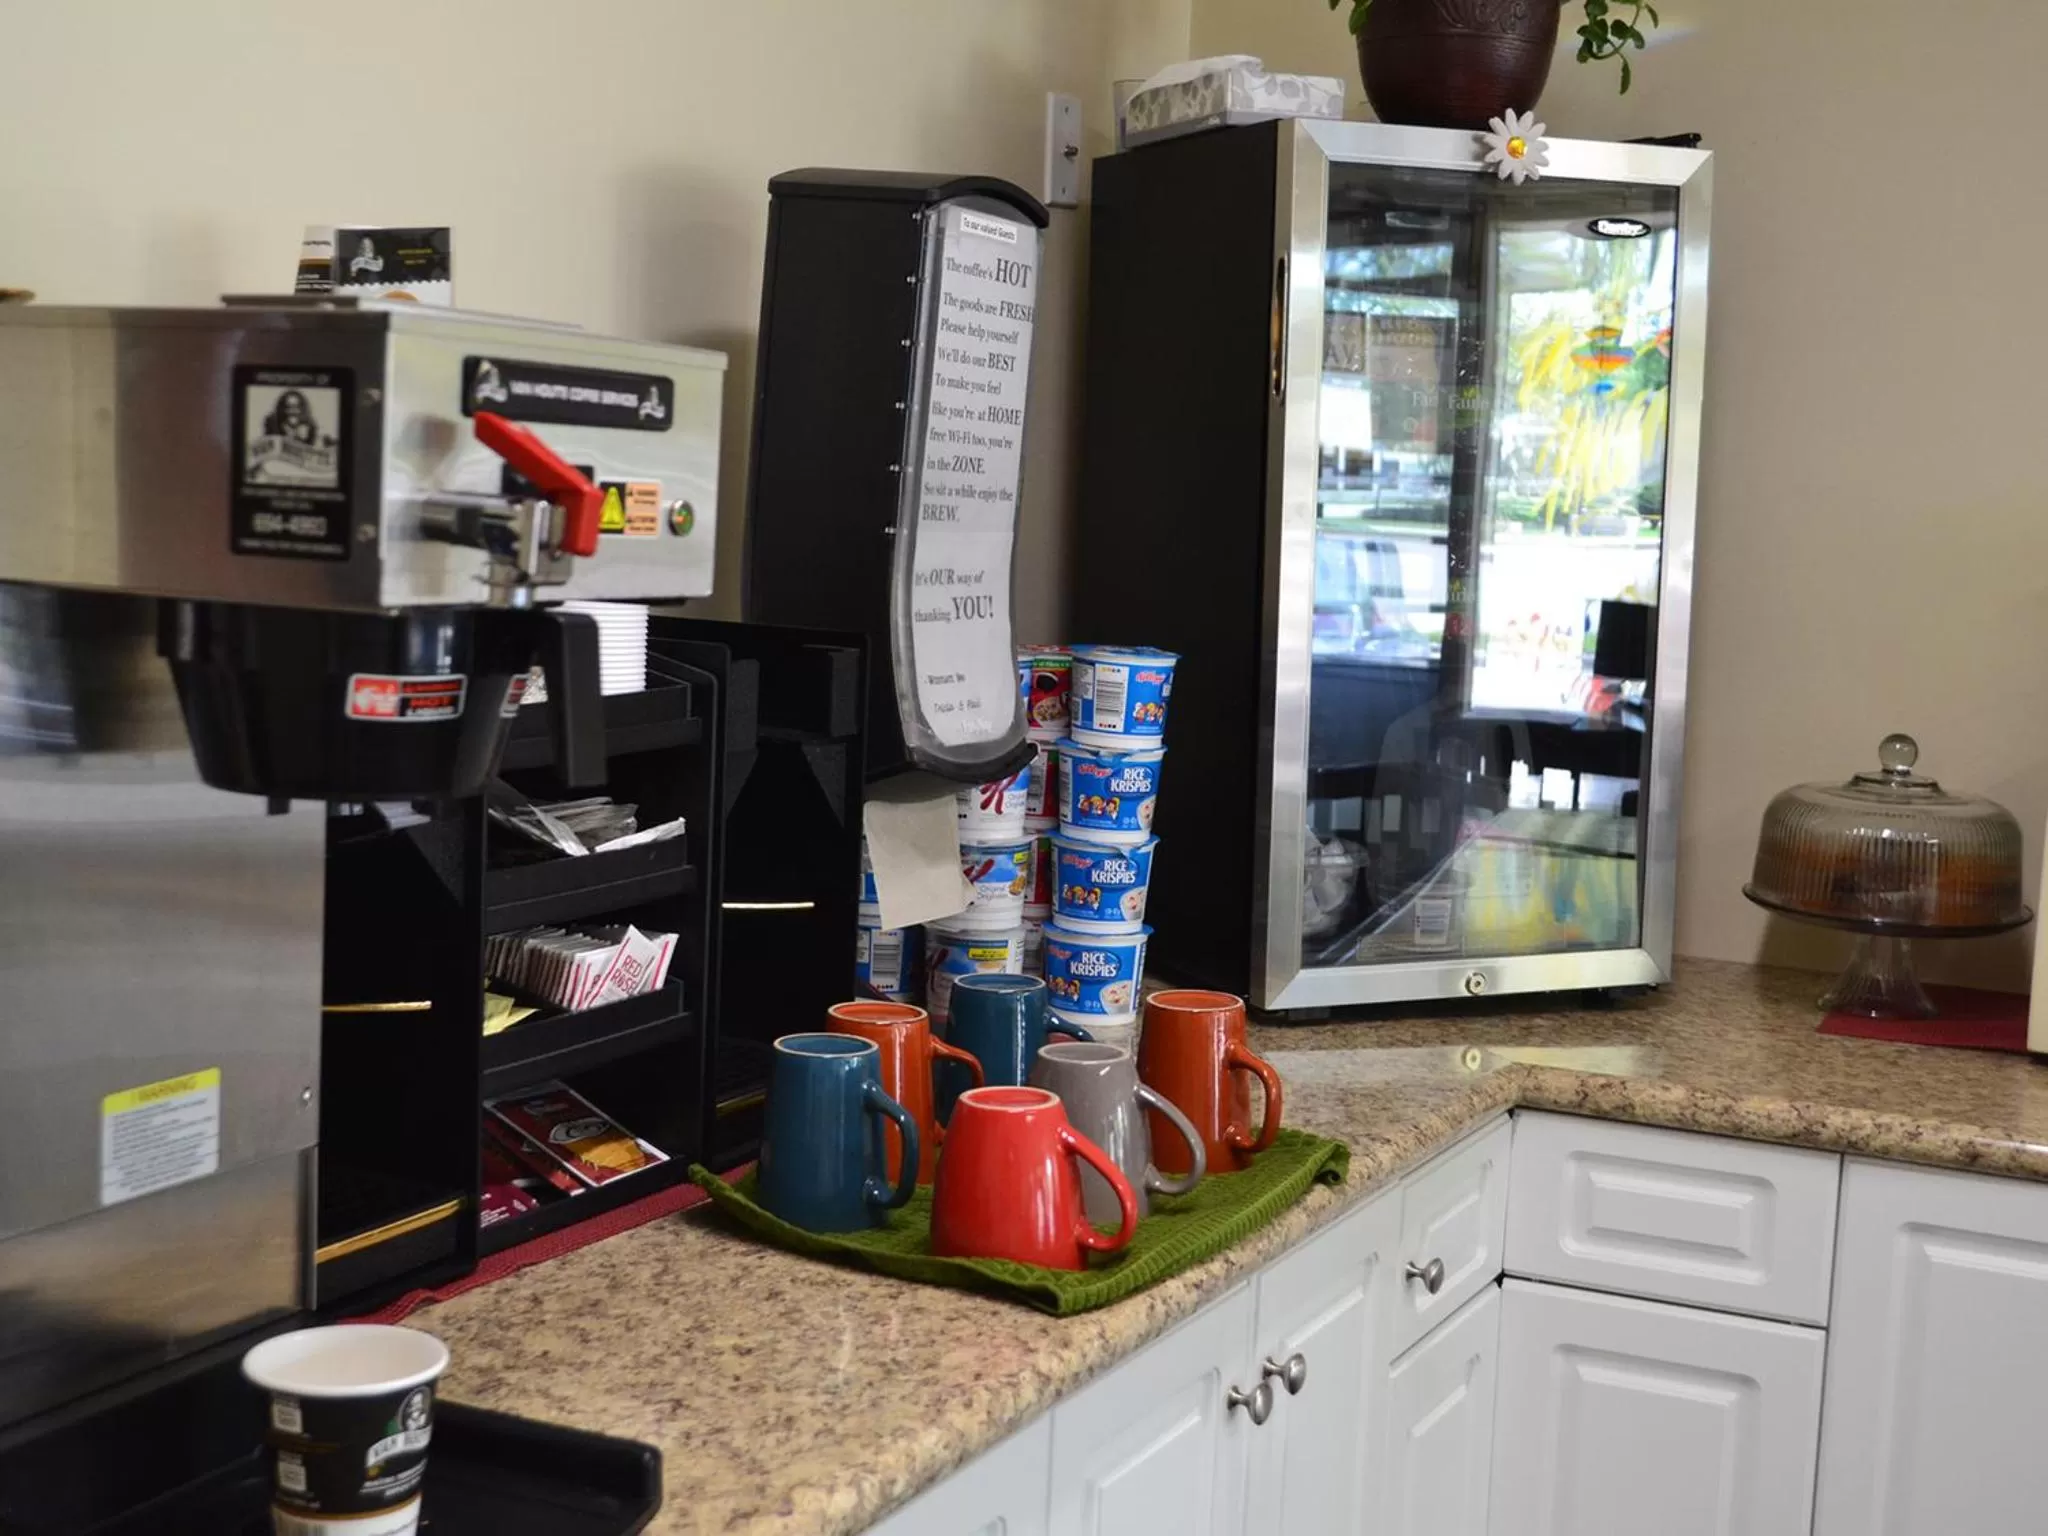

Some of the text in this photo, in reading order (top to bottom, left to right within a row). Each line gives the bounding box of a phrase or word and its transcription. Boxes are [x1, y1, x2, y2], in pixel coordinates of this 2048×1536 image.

[946, 257, 1033, 289] The coffee's HOT
[943, 291, 1034, 324] The goods are FRESH
[941, 317, 1020, 346] Please help yourself
[960, 349, 971, 365] do
[972, 355, 987, 368] our
[987, 352, 1017, 373] BEST
[935, 372, 1002, 396] To make you feel
[931, 400, 948, 417] like
[977, 410, 986, 421] at
[986, 404, 1023, 426] HOME
[926, 454, 936, 470] in
[937, 456, 951, 471] the
[998, 485, 1014, 502] the
[929, 566, 955, 586] OUR
[914, 595, 994, 624] thanking YOU!
[1123, 767, 1146, 781] RICE
[1109, 778, 1152, 794] KRISPIES
[1090, 869, 1137, 885] KRISPIES
[1103, 859, 1128, 873] RICE
[623, 954, 642, 978] RED
[1069, 961, 1118, 977] KRISPIES
[1081, 951, 1106, 966] RICE
[610, 967, 637, 996] ROSE
